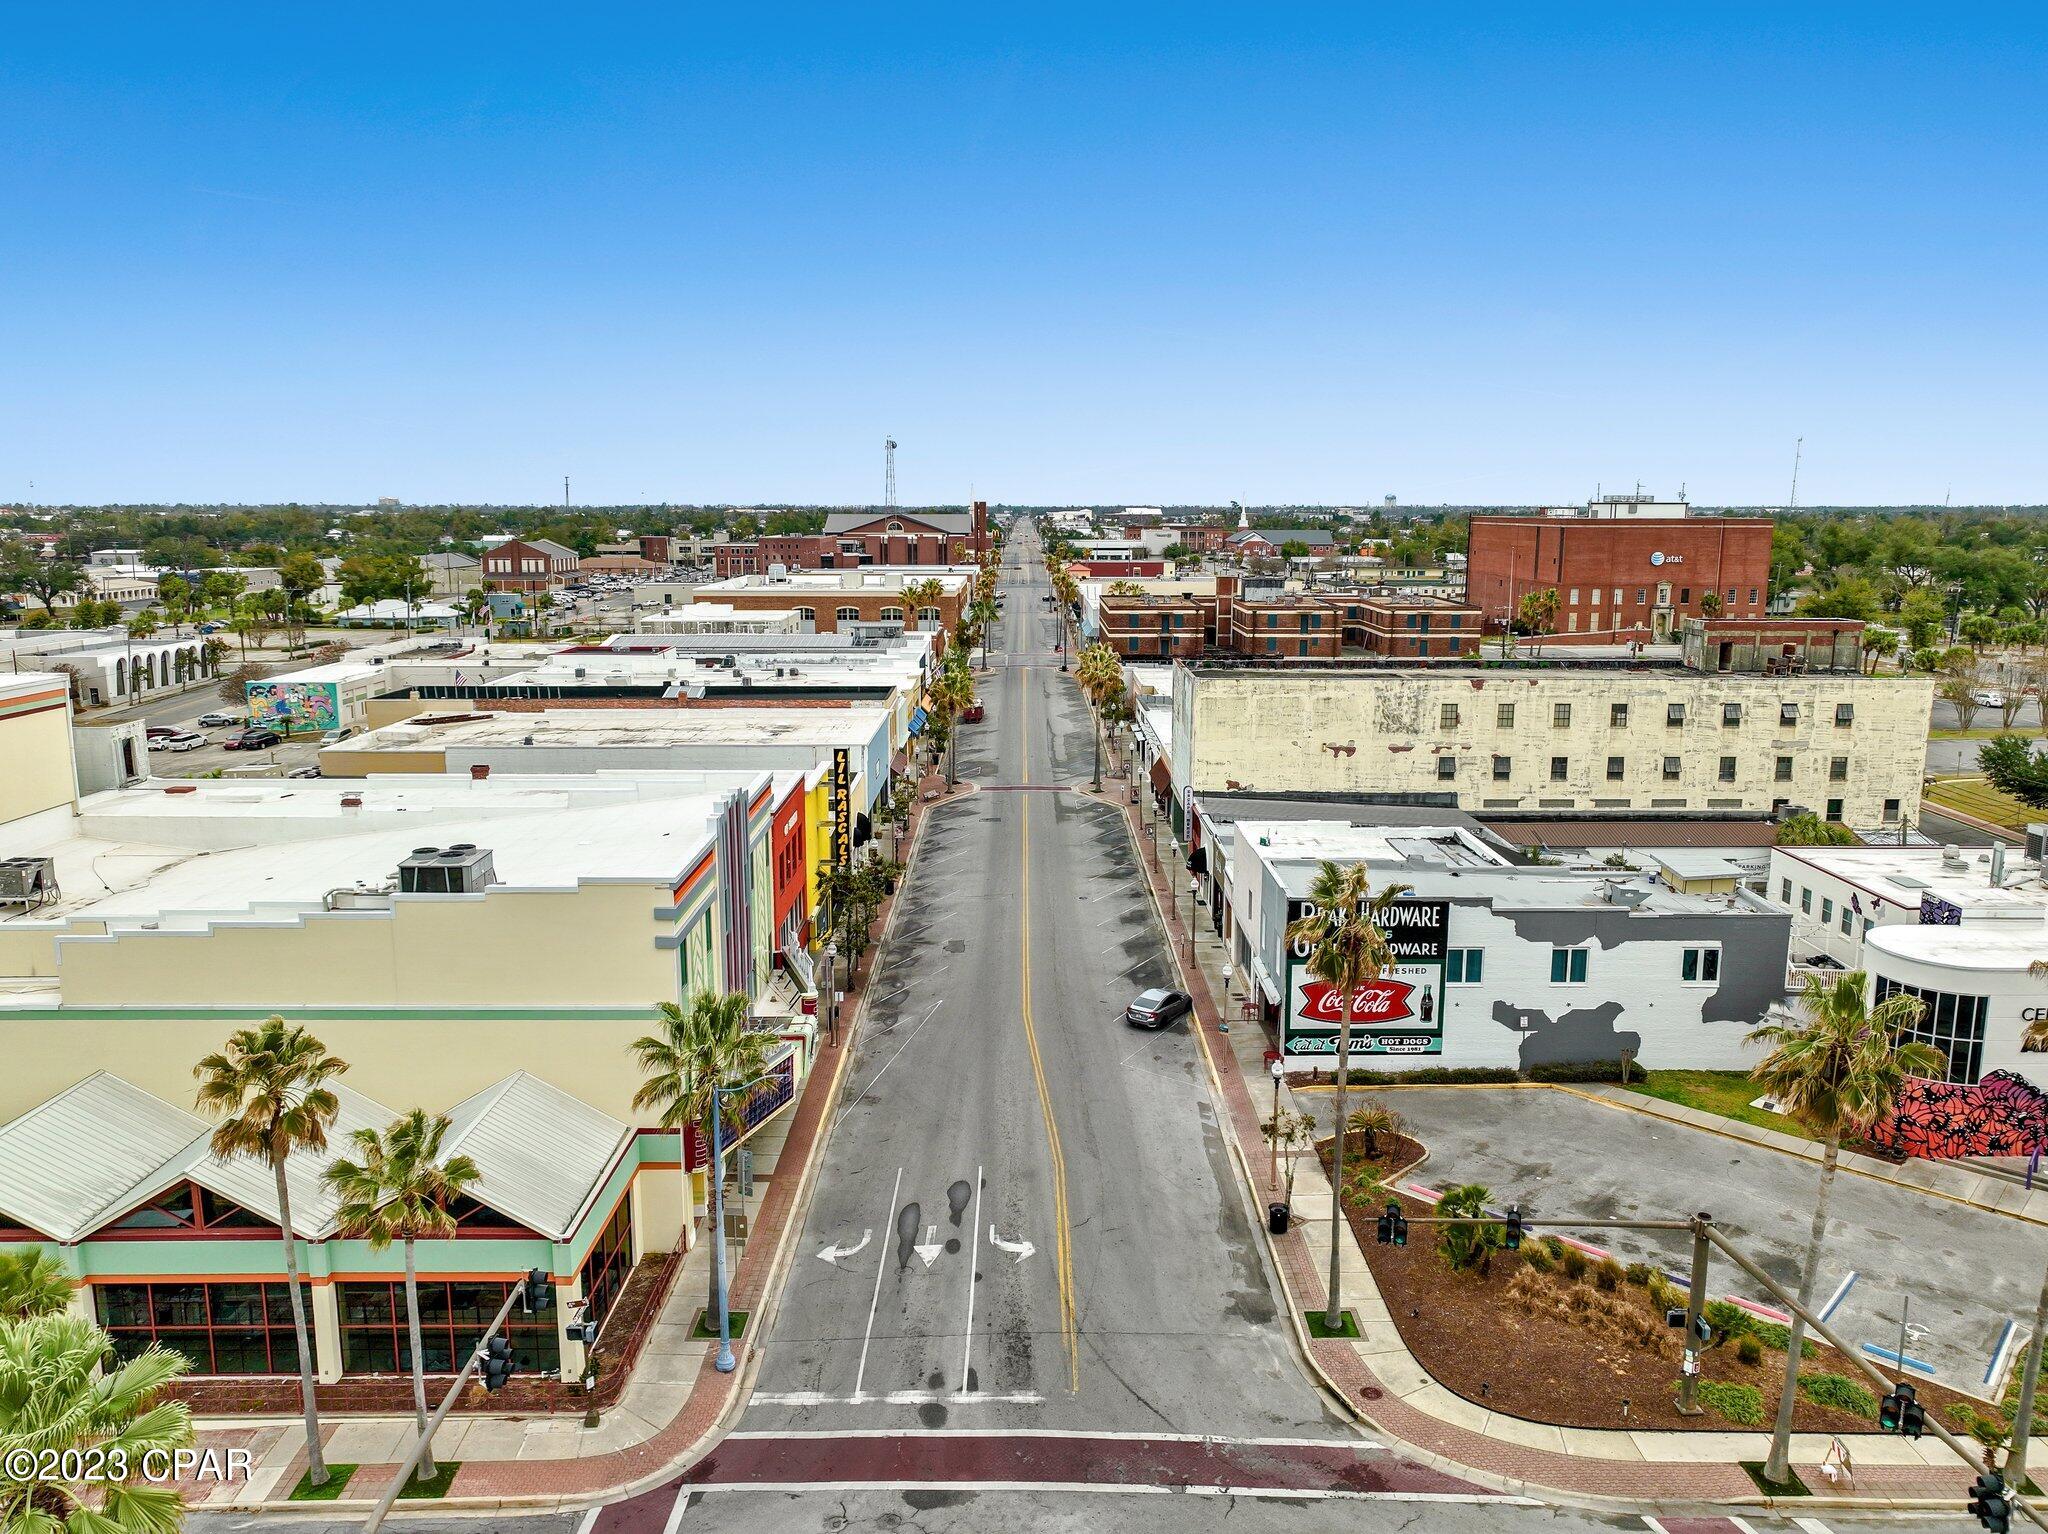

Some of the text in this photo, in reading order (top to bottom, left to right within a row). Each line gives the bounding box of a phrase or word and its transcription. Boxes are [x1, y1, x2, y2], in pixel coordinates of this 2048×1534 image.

[1665, 555, 1683, 563] at&t
[837, 751, 848, 866] LIL RASCALS
[2021, 1007, 2048, 1021] CE
[1293, 1039, 1312, 1051] Eat
[1313, 1039, 1326, 1051] at
[1328, 1034, 1375, 1055] Tm's
